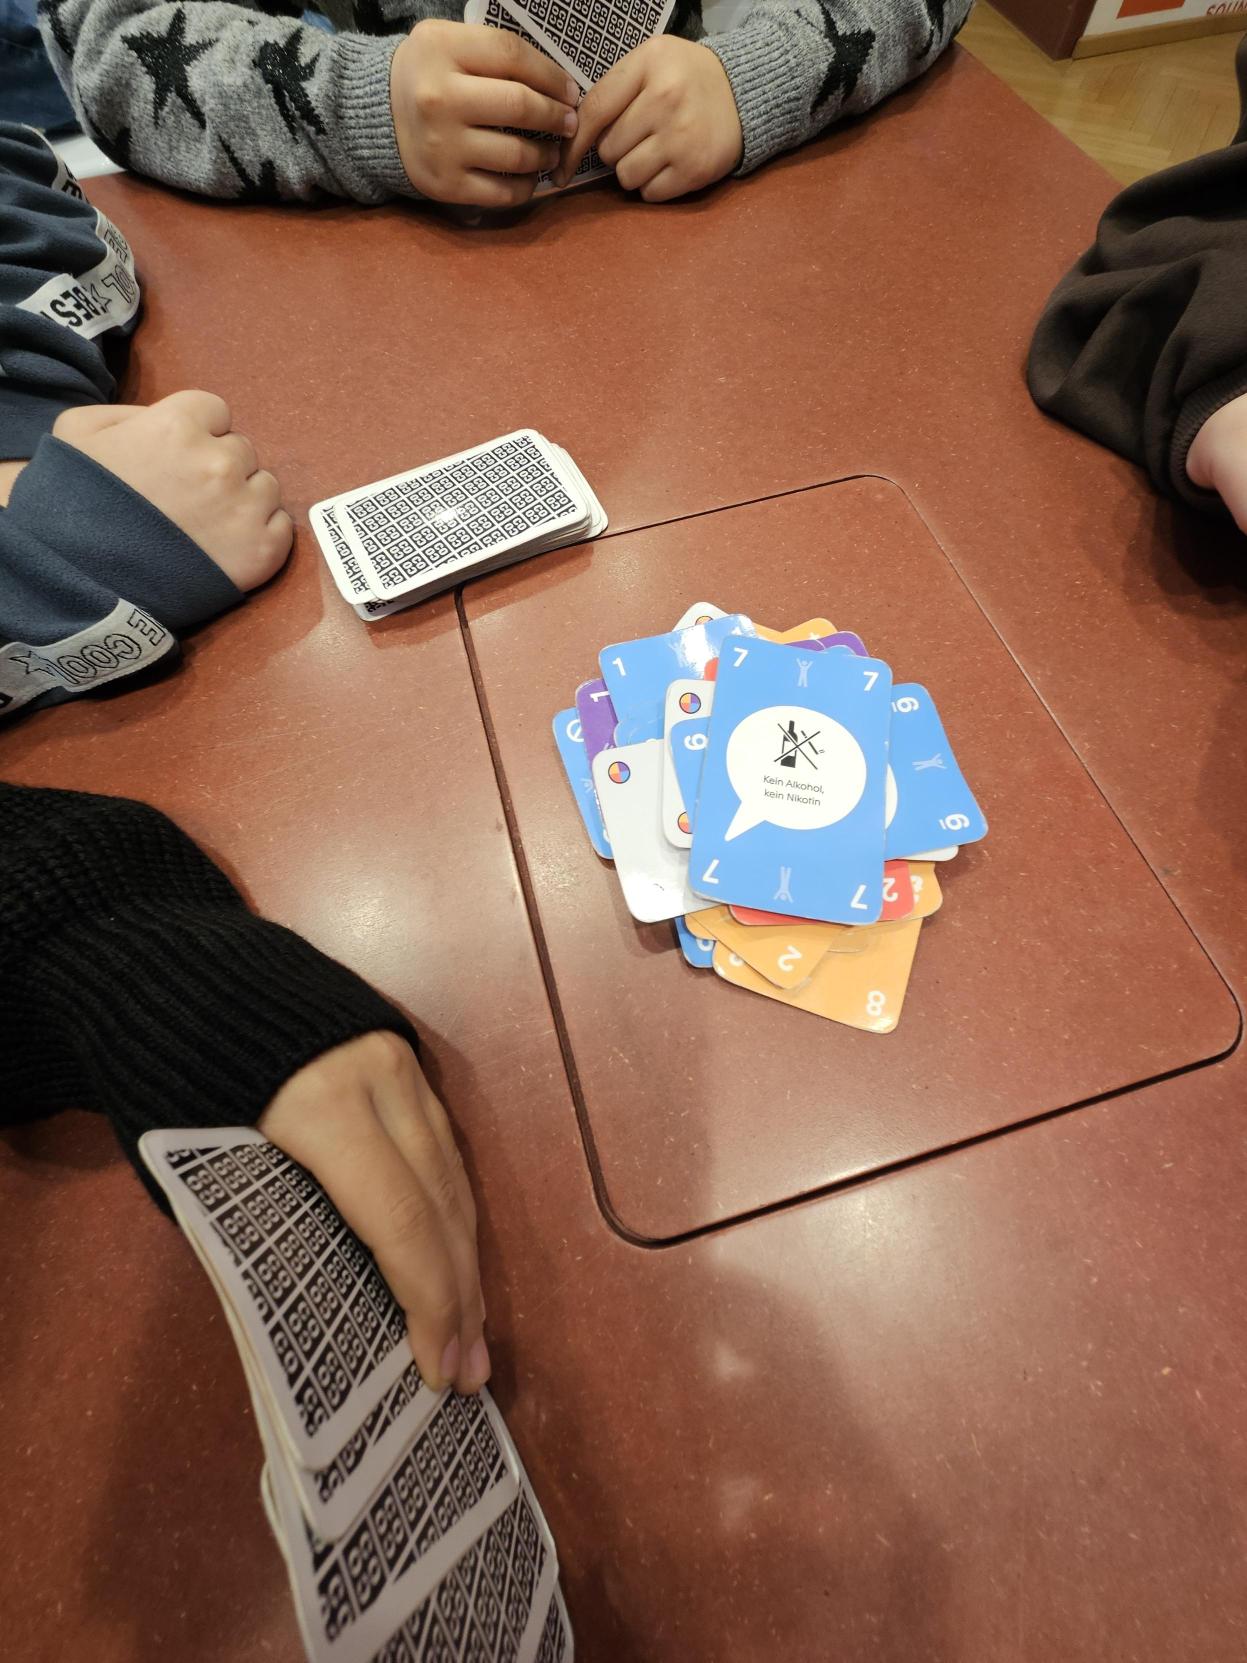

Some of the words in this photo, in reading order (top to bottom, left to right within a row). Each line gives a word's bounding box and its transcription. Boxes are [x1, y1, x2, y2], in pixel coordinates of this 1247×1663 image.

[612, 657, 626, 676] 1
[733, 647, 749, 667] 7
[863, 671, 879, 691] 7
[763, 775, 784, 786] Kein
[785, 779, 824, 794] Alkohol,
[764, 788, 784, 800] kein
[786, 792, 821, 805] Nikotin
[702, 859, 720, 884] 7
[850, 884, 868, 910] 7
[882, 877, 899, 902] 2
[777, 945, 802, 972] 2
[865, 990, 886, 1017] 8
